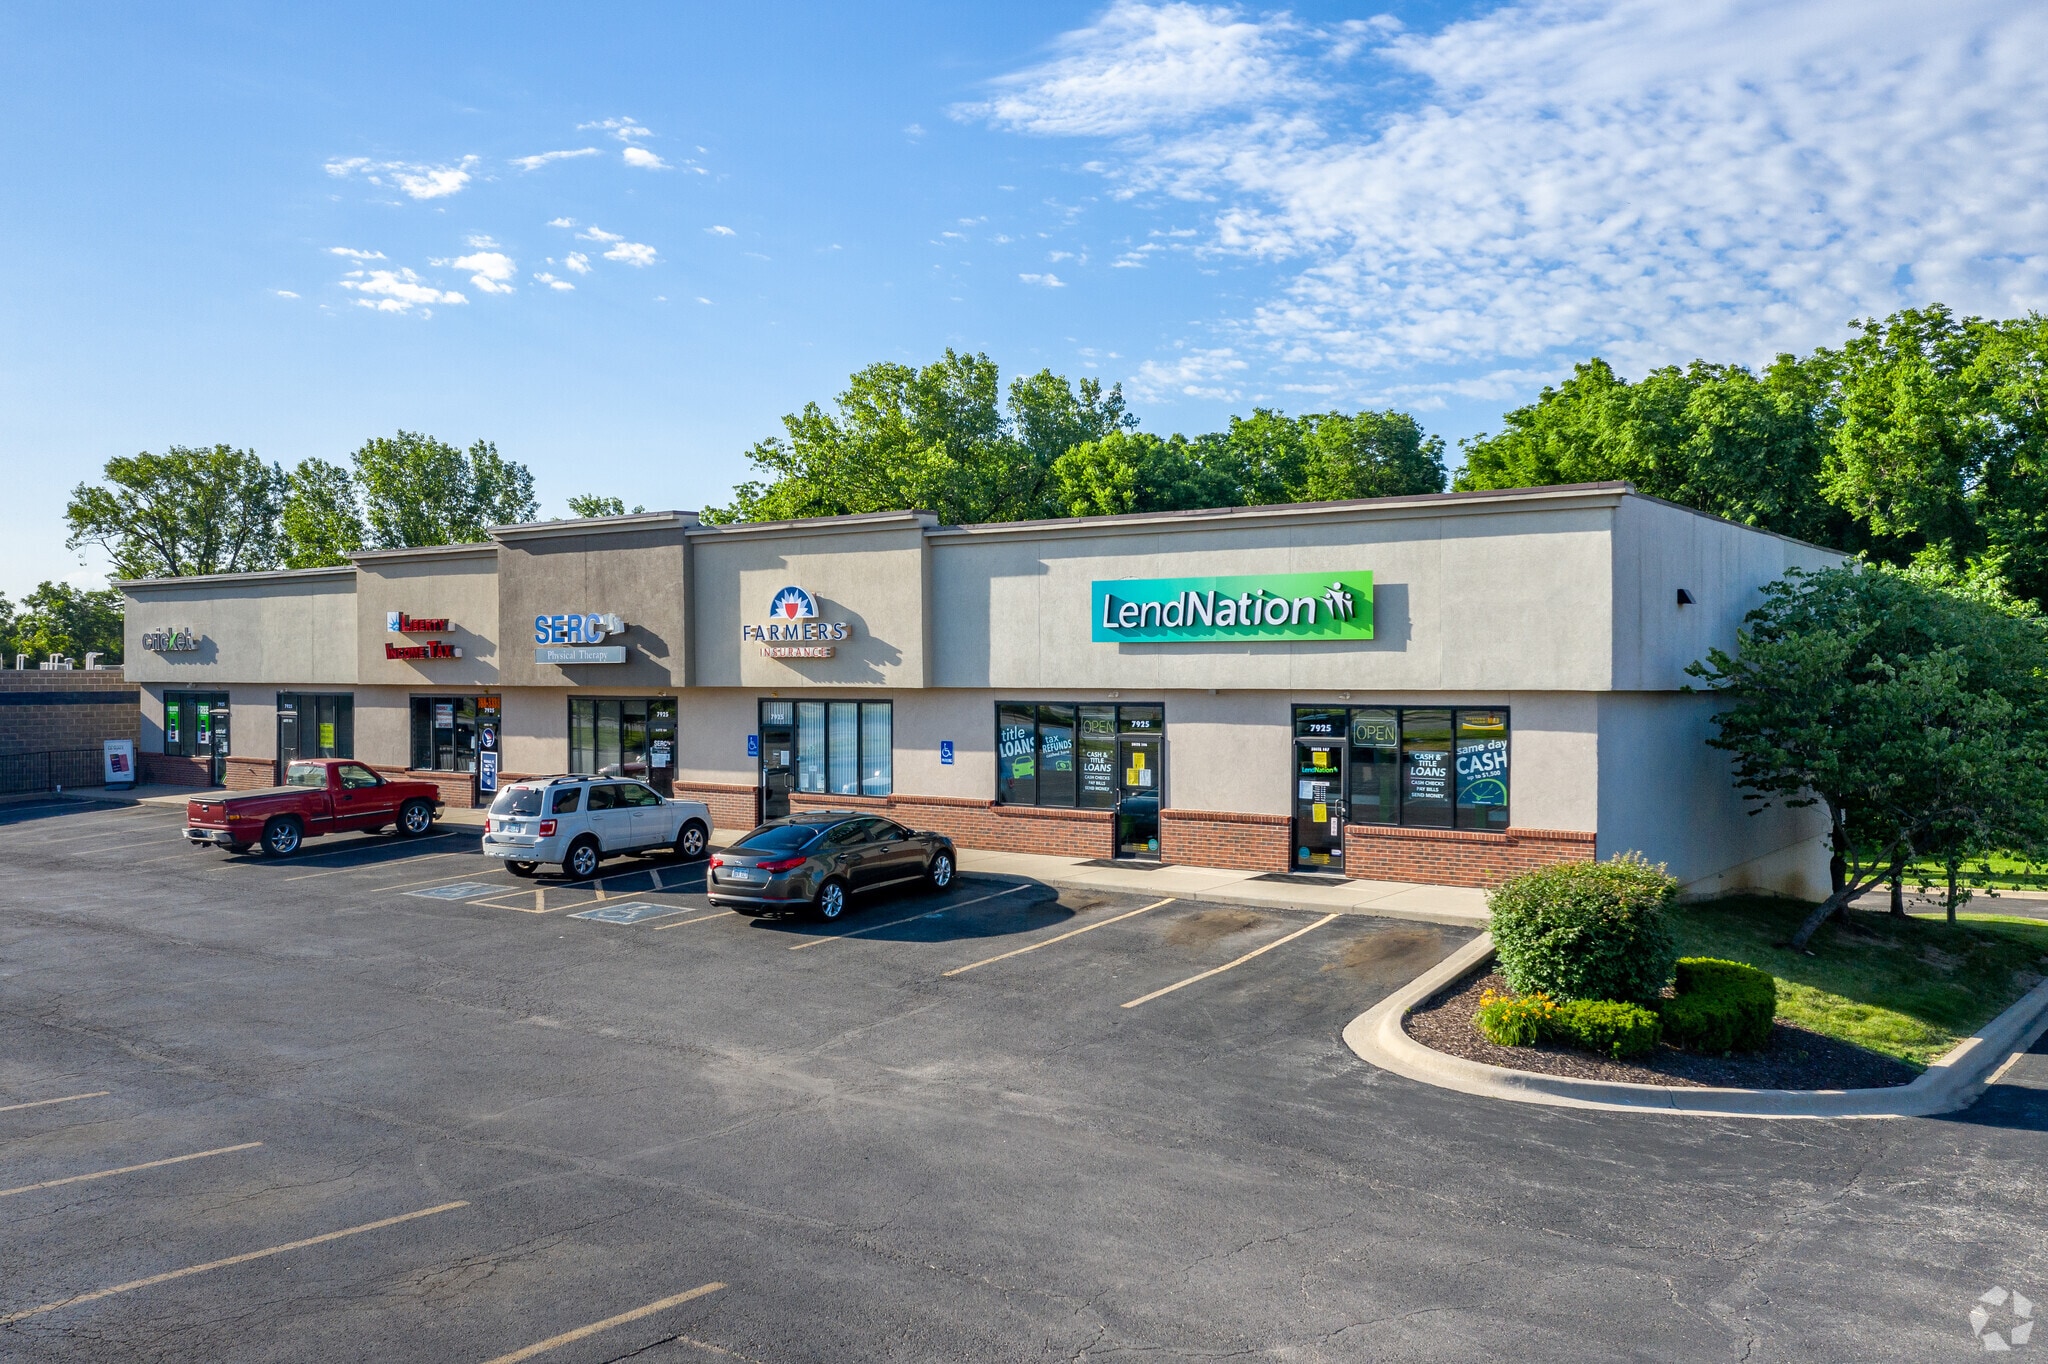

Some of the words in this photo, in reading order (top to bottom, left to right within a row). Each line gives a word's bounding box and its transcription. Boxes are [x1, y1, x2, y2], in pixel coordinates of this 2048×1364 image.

[1103, 589, 1316, 628] LendNation
[401, 613, 446, 632] LIBERTY
[534, 613, 602, 644] SERC
[142, 627, 193, 651] cricket
[743, 624, 846, 641] FARMERS
[385, 642, 425, 660] INCOME
[427, 640, 452, 658] TAX
[547, 650, 576, 663] Physical
[579, 650, 608, 662] Therapy
[760, 647, 827, 657] INSURANCE
[1083, 720, 1114, 734] OPEN
[1131, 720, 1150, 728] 7925
[1310, 724, 1332, 732] 7925
[1001, 725, 1025, 742] title
[1045, 735, 1059, 744] tax
[1356, 725, 1394, 740] OPEN
[1042, 739, 1072, 753] REFUNDS
[1457, 743, 1484, 755] same
[1487, 740, 1508, 753] day
[1415, 753, 1434, 761] CASH
[1456, 751, 1508, 775] CASH
[1084, 763, 1112, 772] LOANS
[1410, 767, 1446, 777] LOANS
[1482, 770, 1501, 778] $1,500
